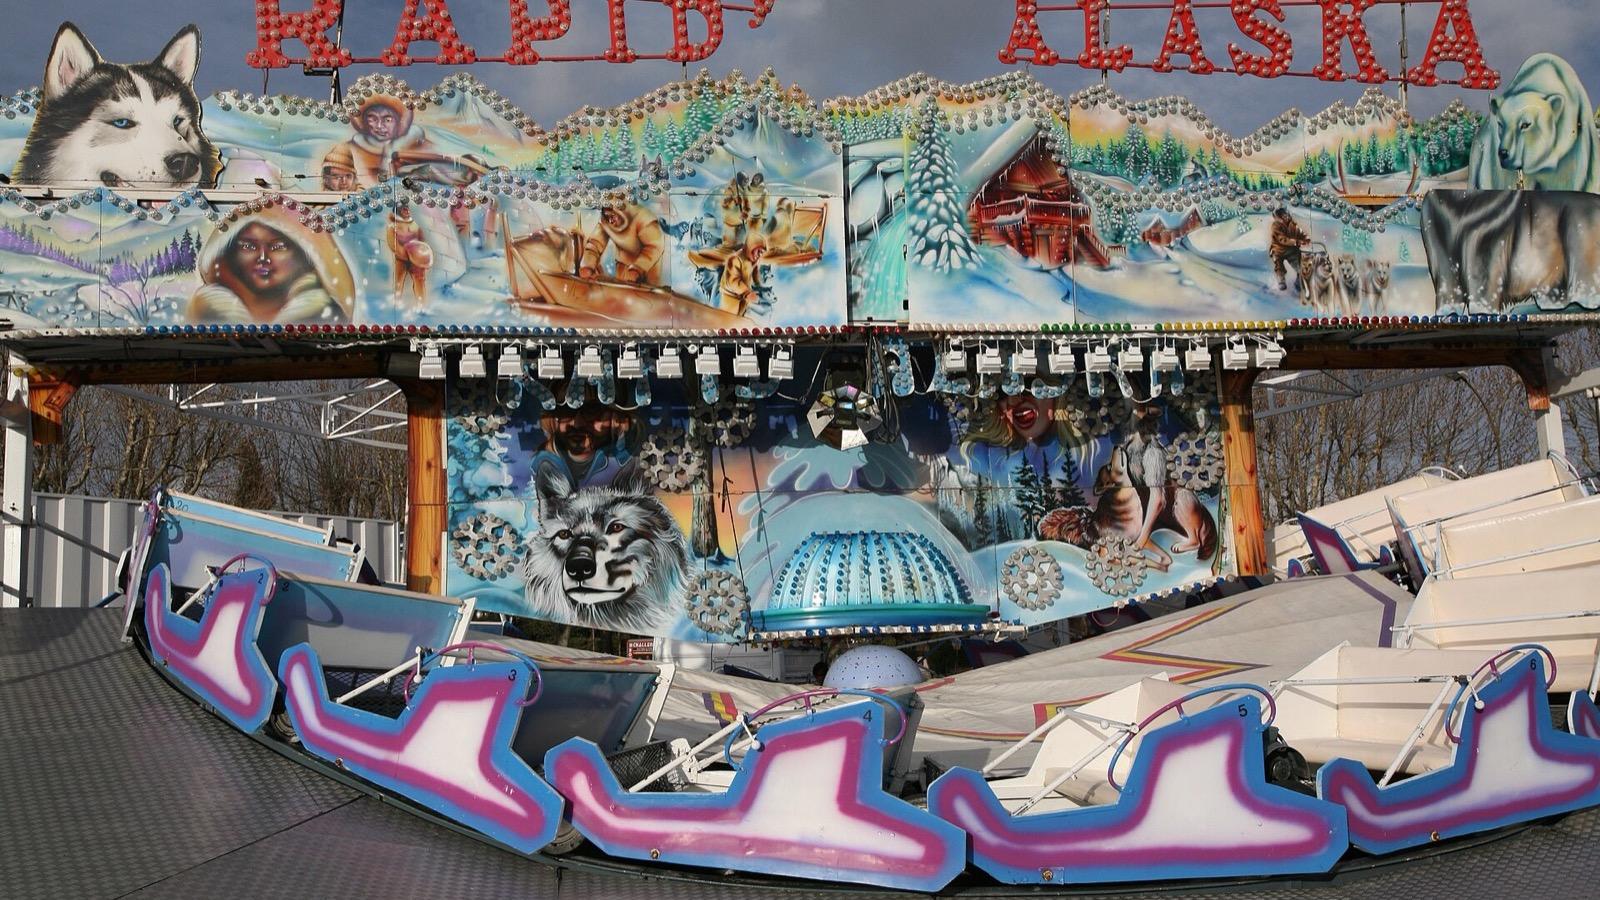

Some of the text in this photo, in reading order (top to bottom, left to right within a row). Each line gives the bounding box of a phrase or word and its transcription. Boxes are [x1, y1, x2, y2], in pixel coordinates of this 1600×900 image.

[998, 0, 1501, 90] ALASKA
[257, 573, 264, 585] 2
[1530, 658, 1537, 671] 6
[508, 669, 517, 681] 3
[863, 709, 872, 722] 4
[1238, 703, 1248, 717] 5
